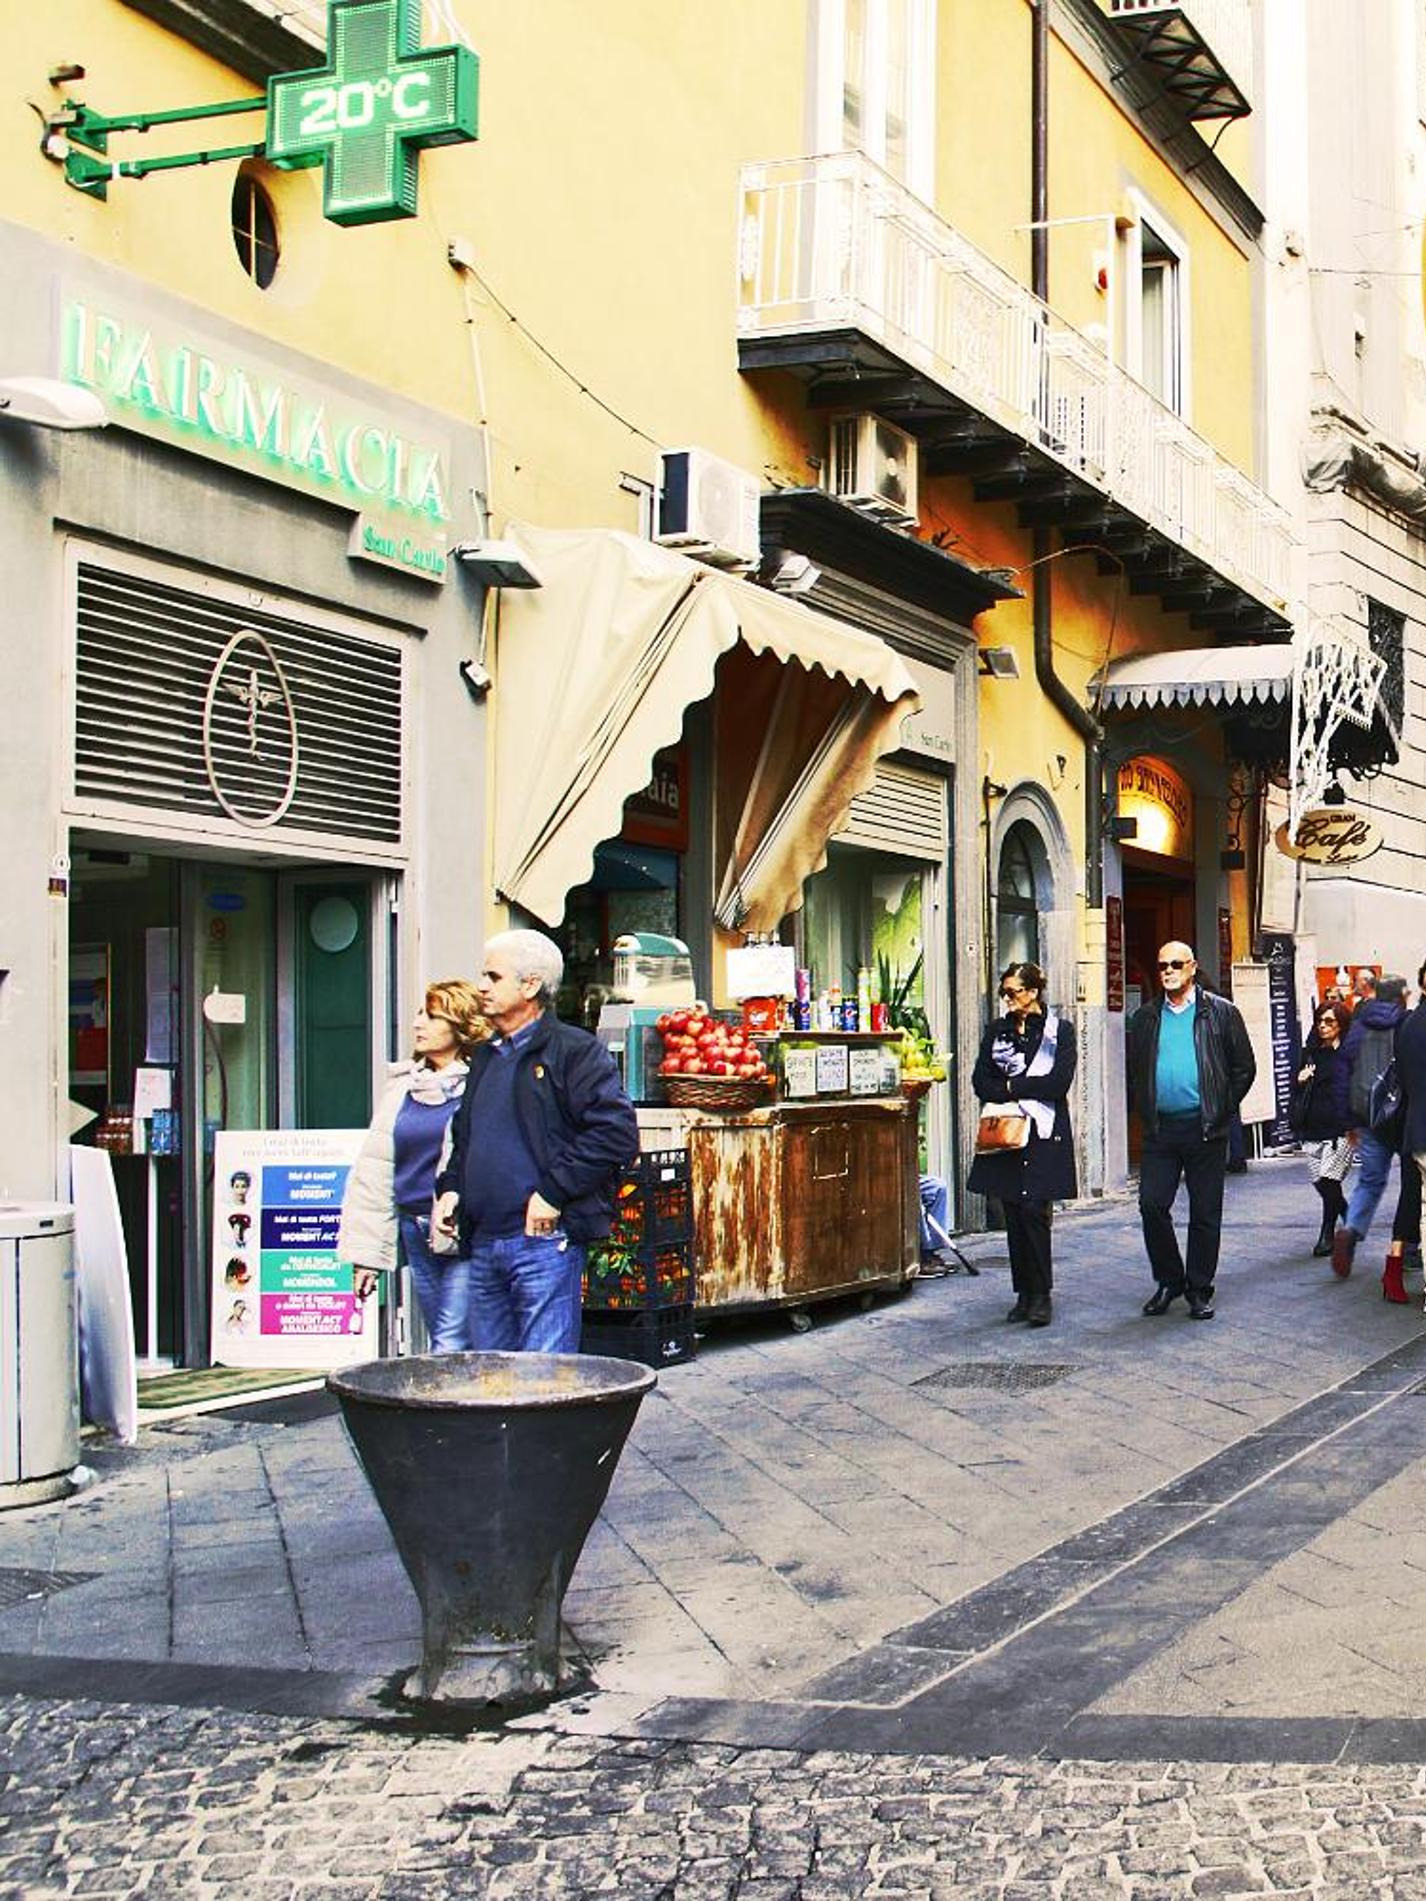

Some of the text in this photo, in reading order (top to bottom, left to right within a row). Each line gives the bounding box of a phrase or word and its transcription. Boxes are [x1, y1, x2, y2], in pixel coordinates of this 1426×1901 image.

[300, 71, 431, 135] 20°C
[65, 302, 450, 522] FARMACIA
[363, 526, 447, 575] San Carlo
